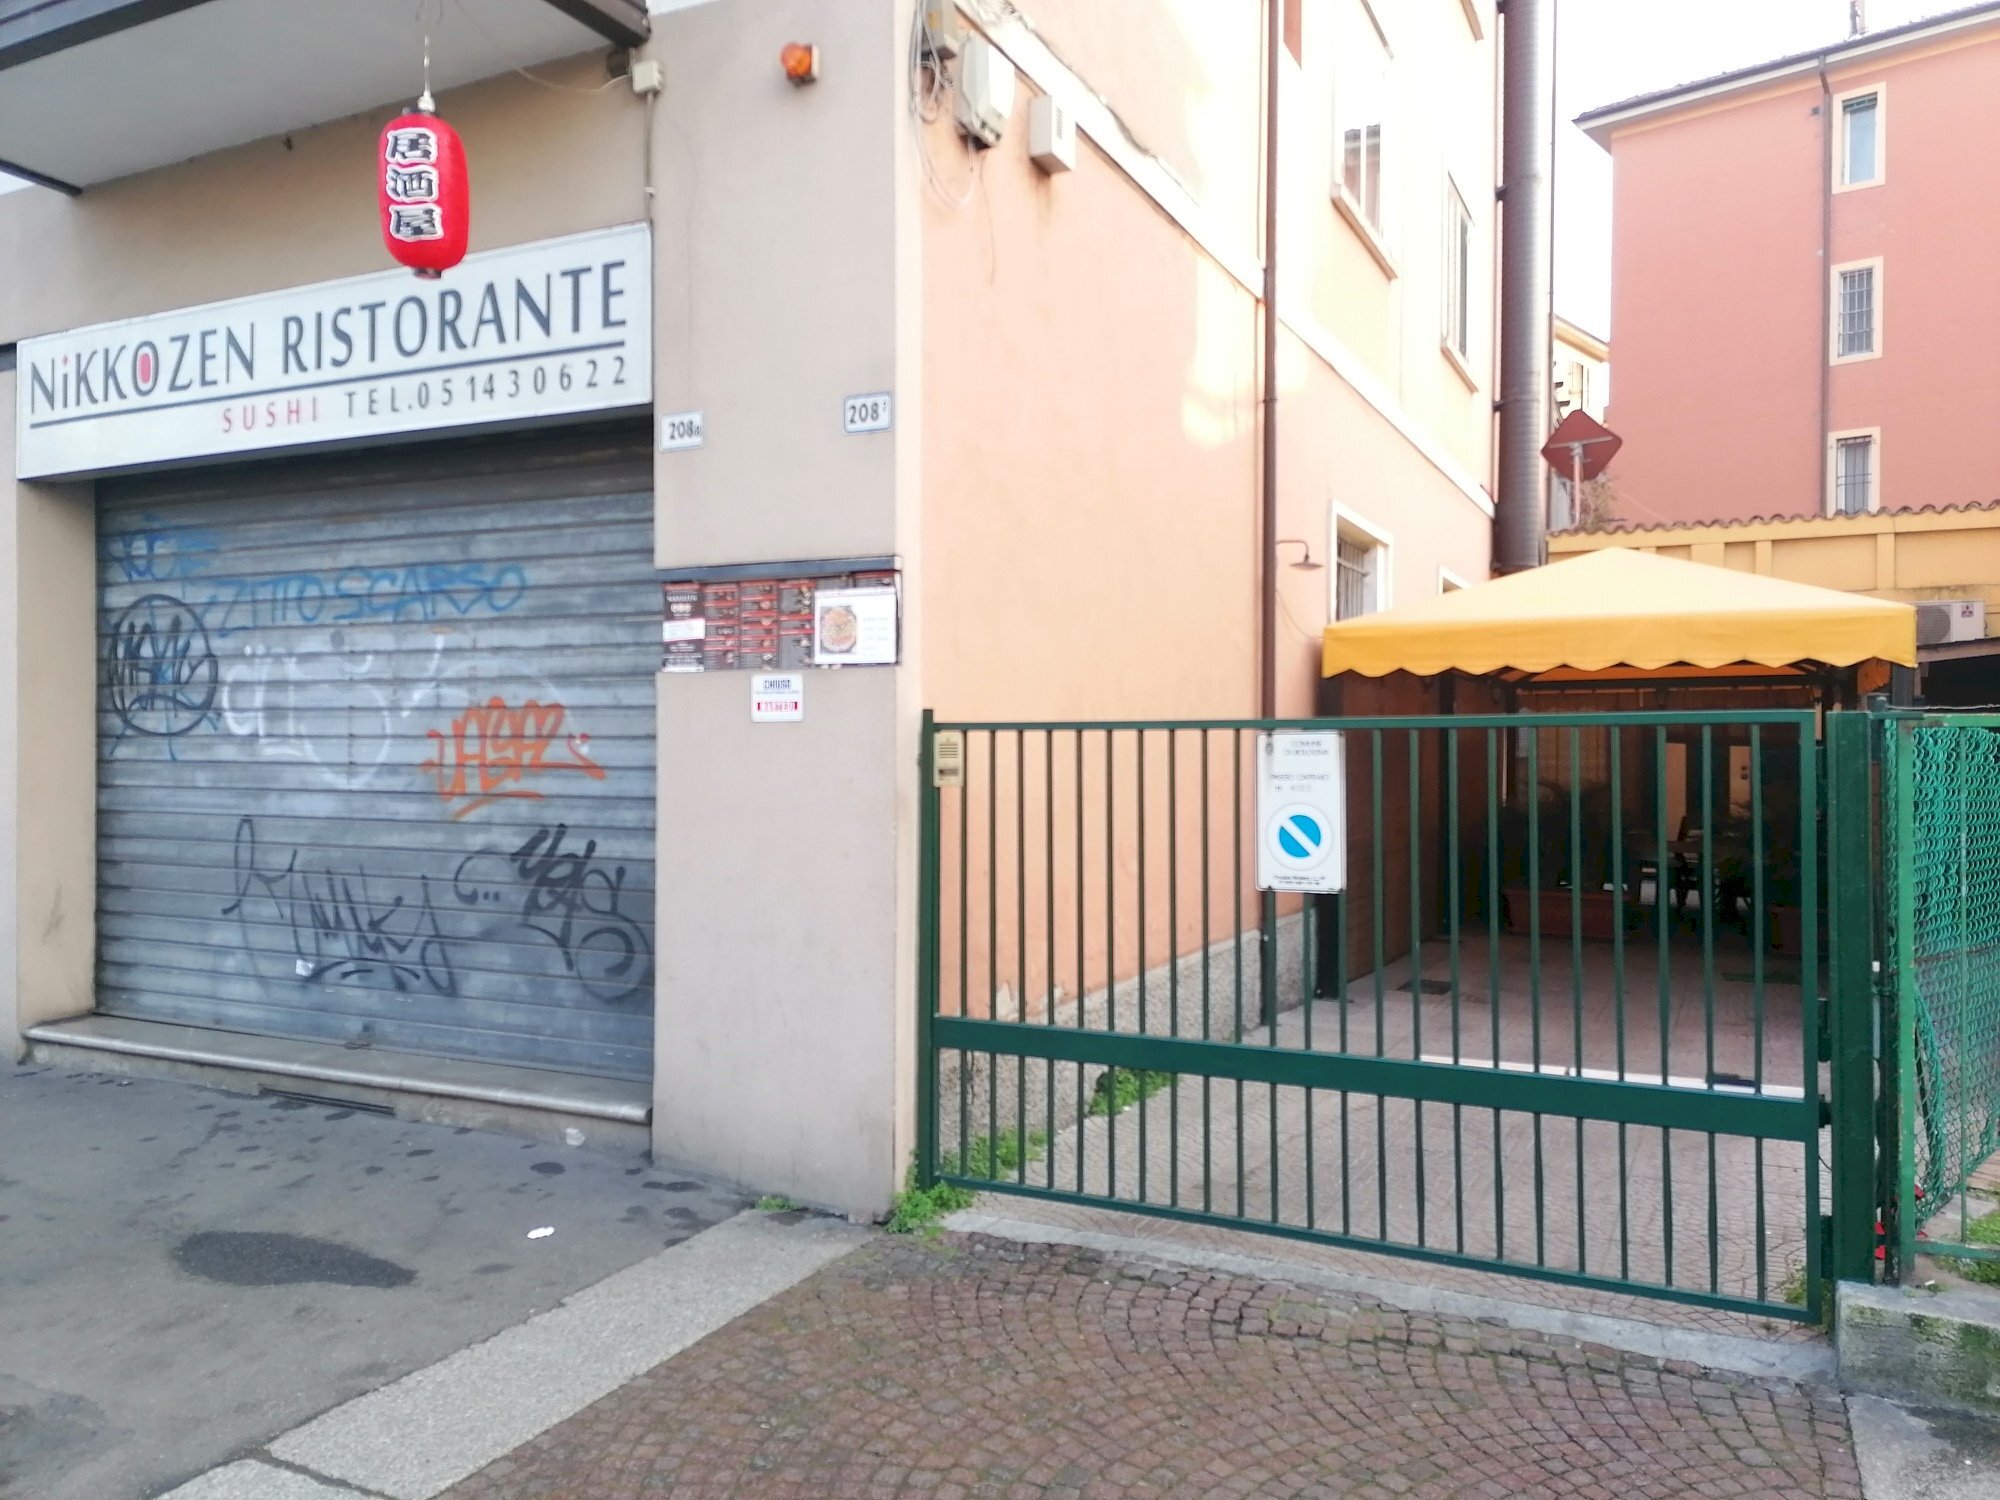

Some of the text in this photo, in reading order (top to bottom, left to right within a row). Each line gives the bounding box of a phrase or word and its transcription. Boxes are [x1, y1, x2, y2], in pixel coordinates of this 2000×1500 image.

[386, 129, 441, 240] 居酒屋
[282, 260, 627, 375] RISTORANTE
[222, 396, 318, 433] SUSHI
